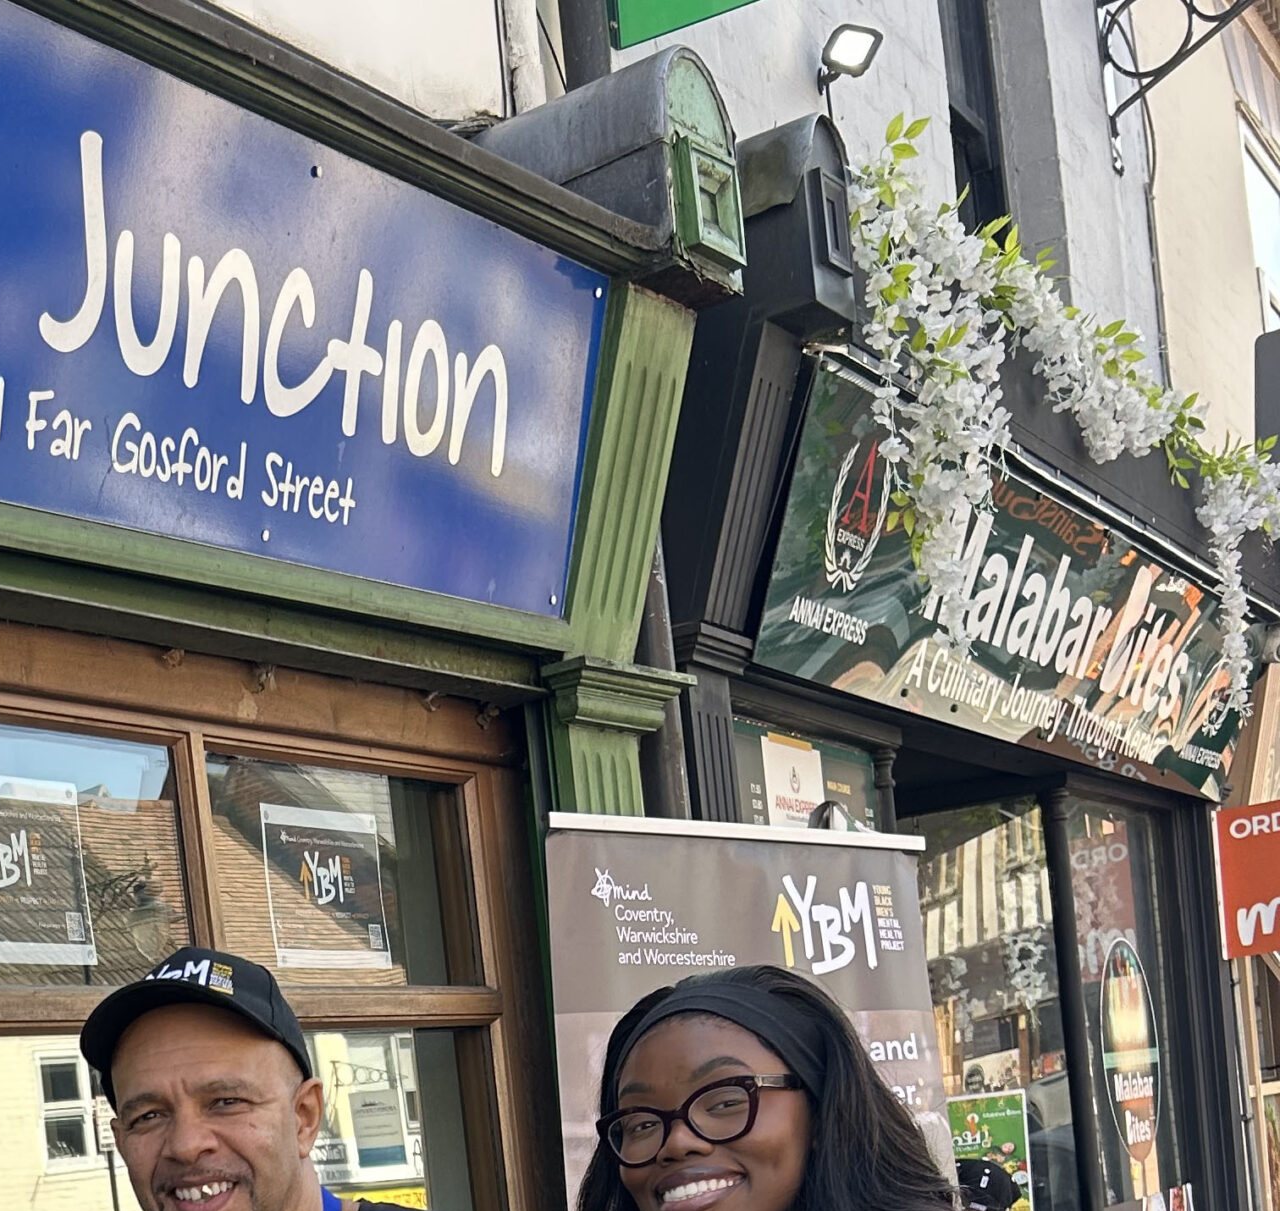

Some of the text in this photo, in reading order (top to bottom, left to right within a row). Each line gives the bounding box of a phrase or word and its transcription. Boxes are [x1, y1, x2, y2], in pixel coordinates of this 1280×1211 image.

[39, 131, 508, 477] Junction
[26, 391, 91, 461] Far
[112, 413, 246, 501] Gosford
[262, 453, 357, 526] Street
[836, 528, 865, 552] EXPRESS
[789, 595, 868, 645] ANNAI EXPRESS
[905, 638, 930, 687] A
[927, 649, 1004, 722] Culinary
[1001, 673, 1066, 742] Journey
[1066, 695, 1121, 759] Through
[304, 851, 344, 905] YBM
[613, 883, 652, 901] mind
[615, 905, 674, 925] Coventry,
[782, 874, 878, 975] YBM
[616, 926, 698, 945] Warwickshire
[880, 939, 905, 951] PROJECT
[618, 949, 736, 967] and Worcestershire
[870, 1032, 919, 1062] and
[1114, 1071, 1154, 1102] Malabar
